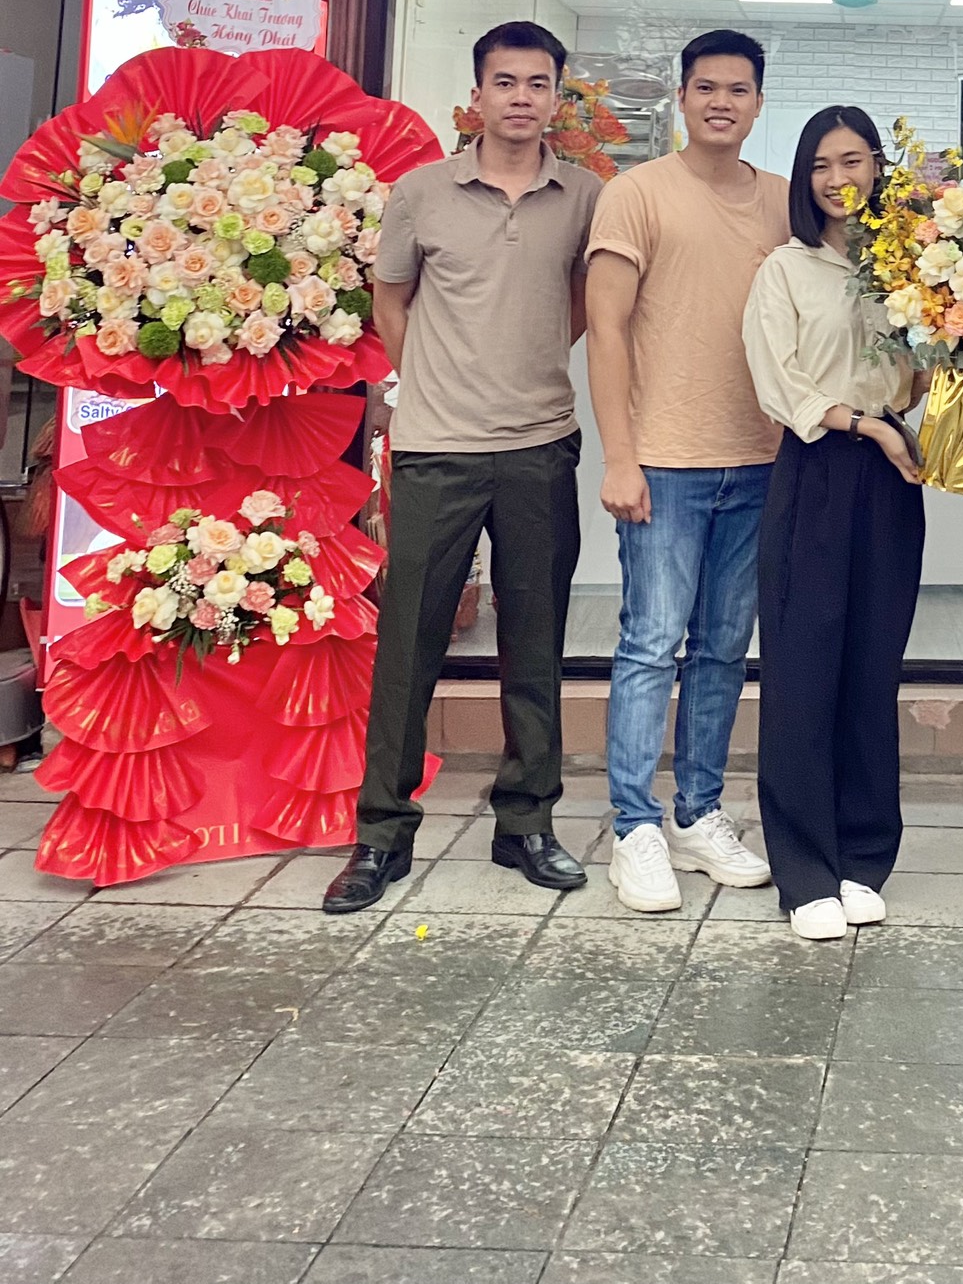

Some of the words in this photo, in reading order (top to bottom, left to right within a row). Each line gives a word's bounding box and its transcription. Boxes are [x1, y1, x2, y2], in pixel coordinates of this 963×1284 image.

[221, 2, 253, 21] Khai
[259, 7, 304, 28] Trương
[210, 23, 253, 45] Hồng
[257, 28, 297, 47] Phát
